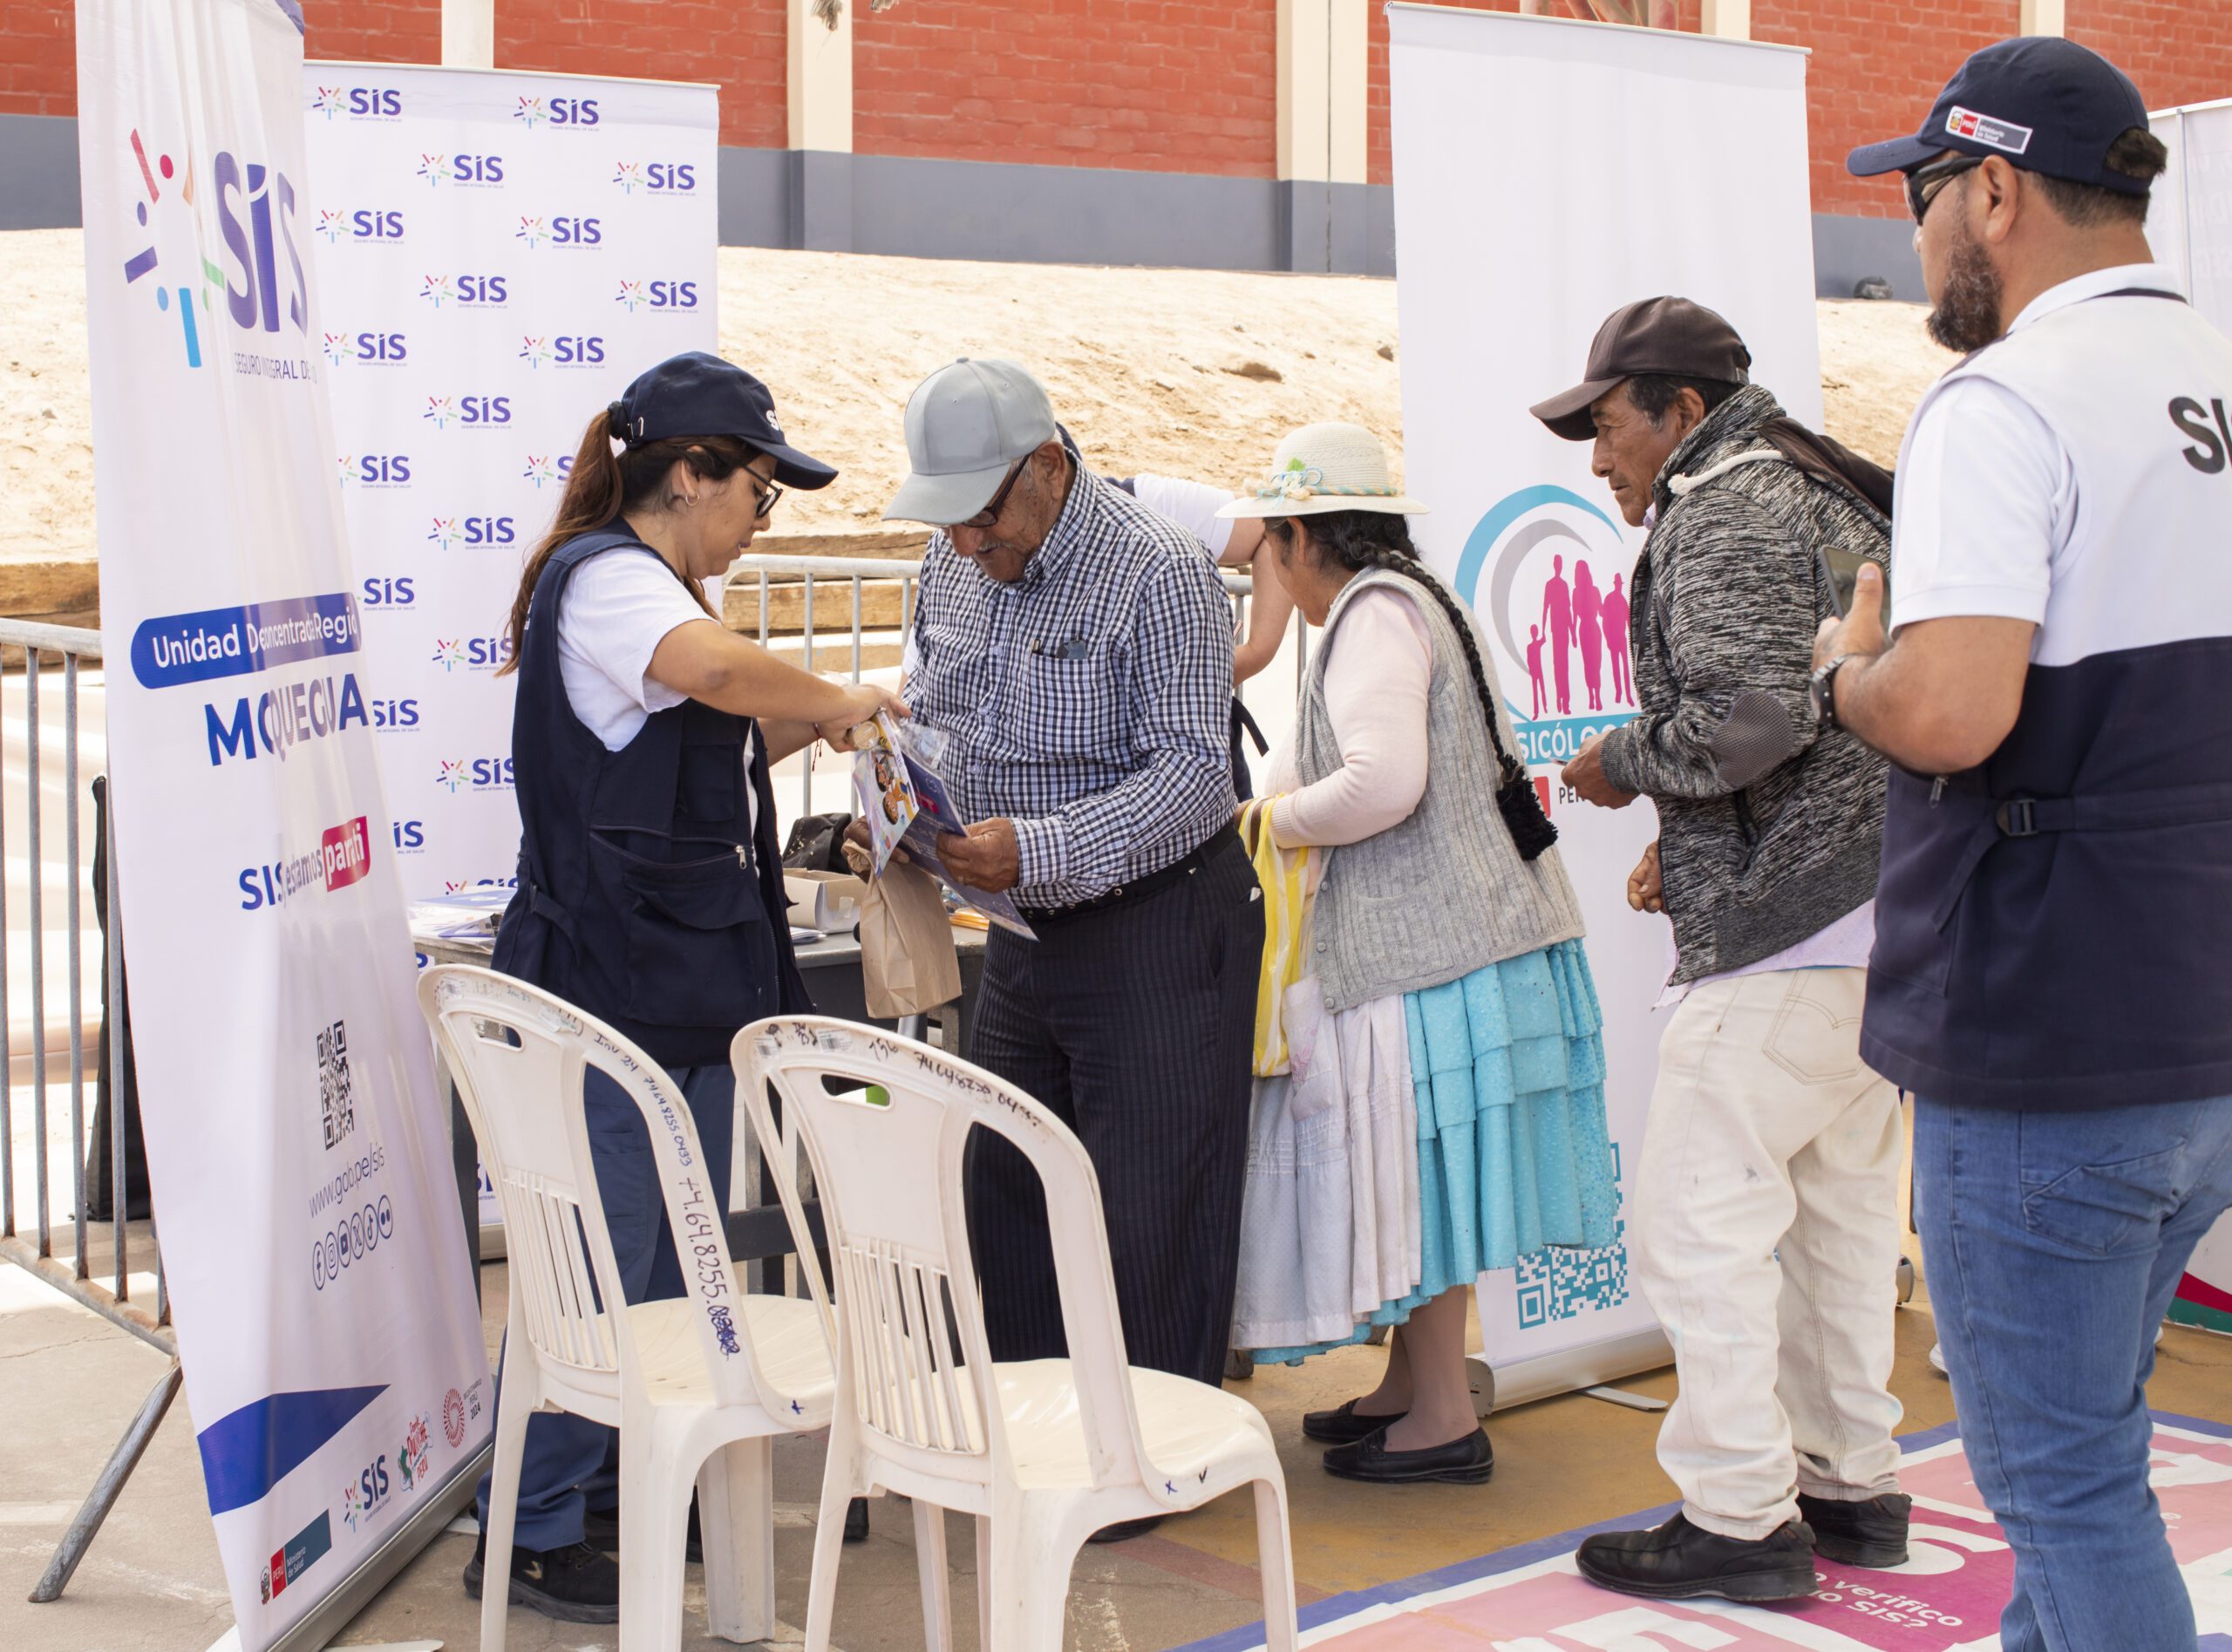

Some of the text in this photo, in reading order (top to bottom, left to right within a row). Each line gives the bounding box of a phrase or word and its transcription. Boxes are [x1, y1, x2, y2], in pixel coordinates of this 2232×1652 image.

[153, 623, 242, 669] Unidad
[393, 820, 424, 848] iS
[621, 1055, 639, 1072] 24
[310, 1142, 385, 1218] www.gob.pe/sis
[471, 1401, 481, 1420] 2024
[1834, 1581, 1963, 1628] verifico
[1847, 1601, 1929, 1628] SIS?
